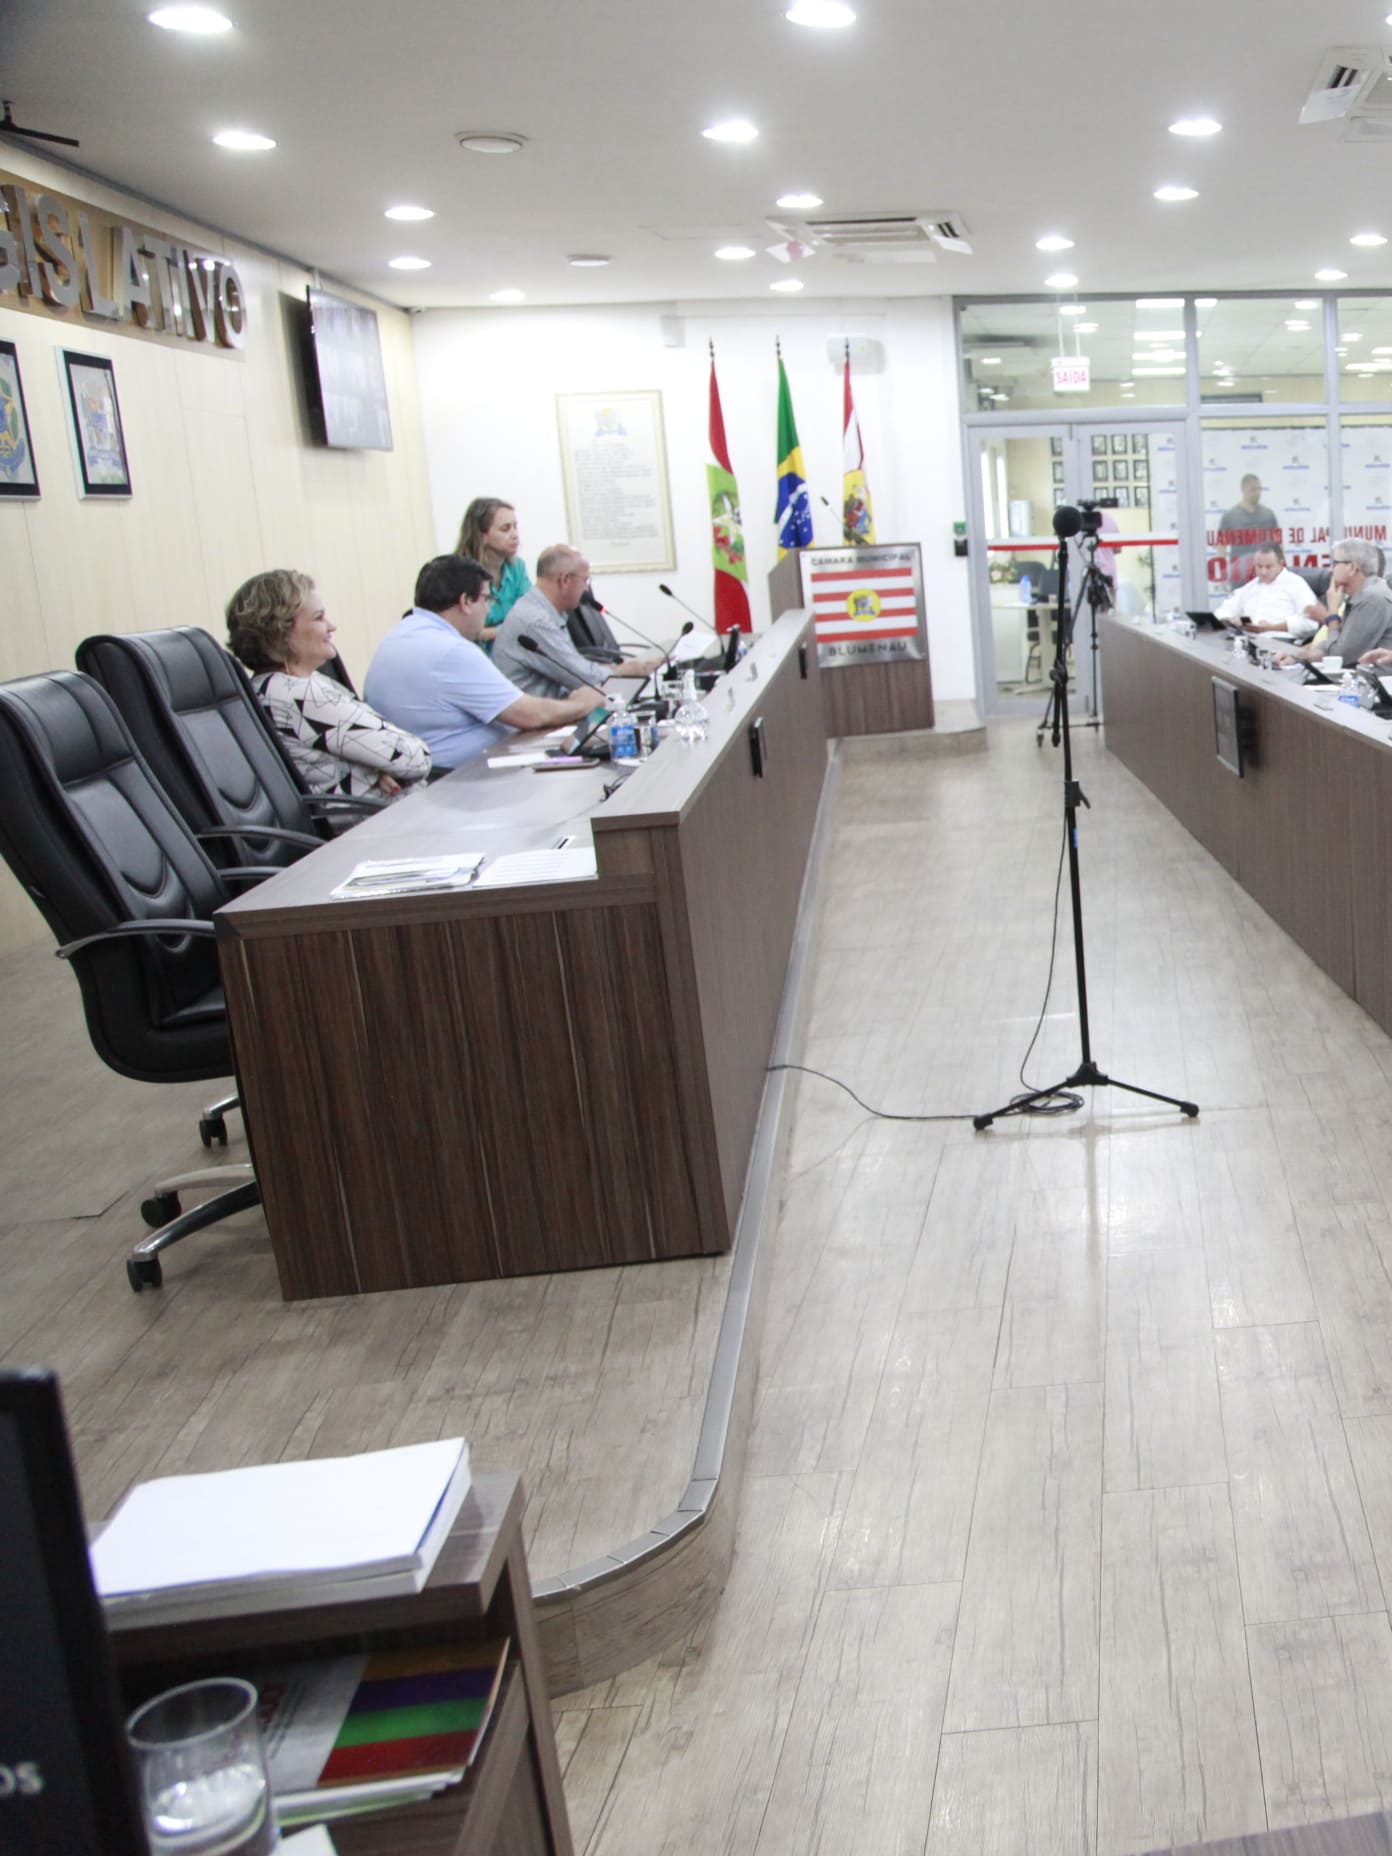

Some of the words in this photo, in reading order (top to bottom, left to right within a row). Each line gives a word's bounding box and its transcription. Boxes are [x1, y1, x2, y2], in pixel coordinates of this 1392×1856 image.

[1056, 369, 1087, 385] SAÍDA
[811, 556, 853, 566] CÂMARA
[828, 641, 907, 657] BLUMENAU
